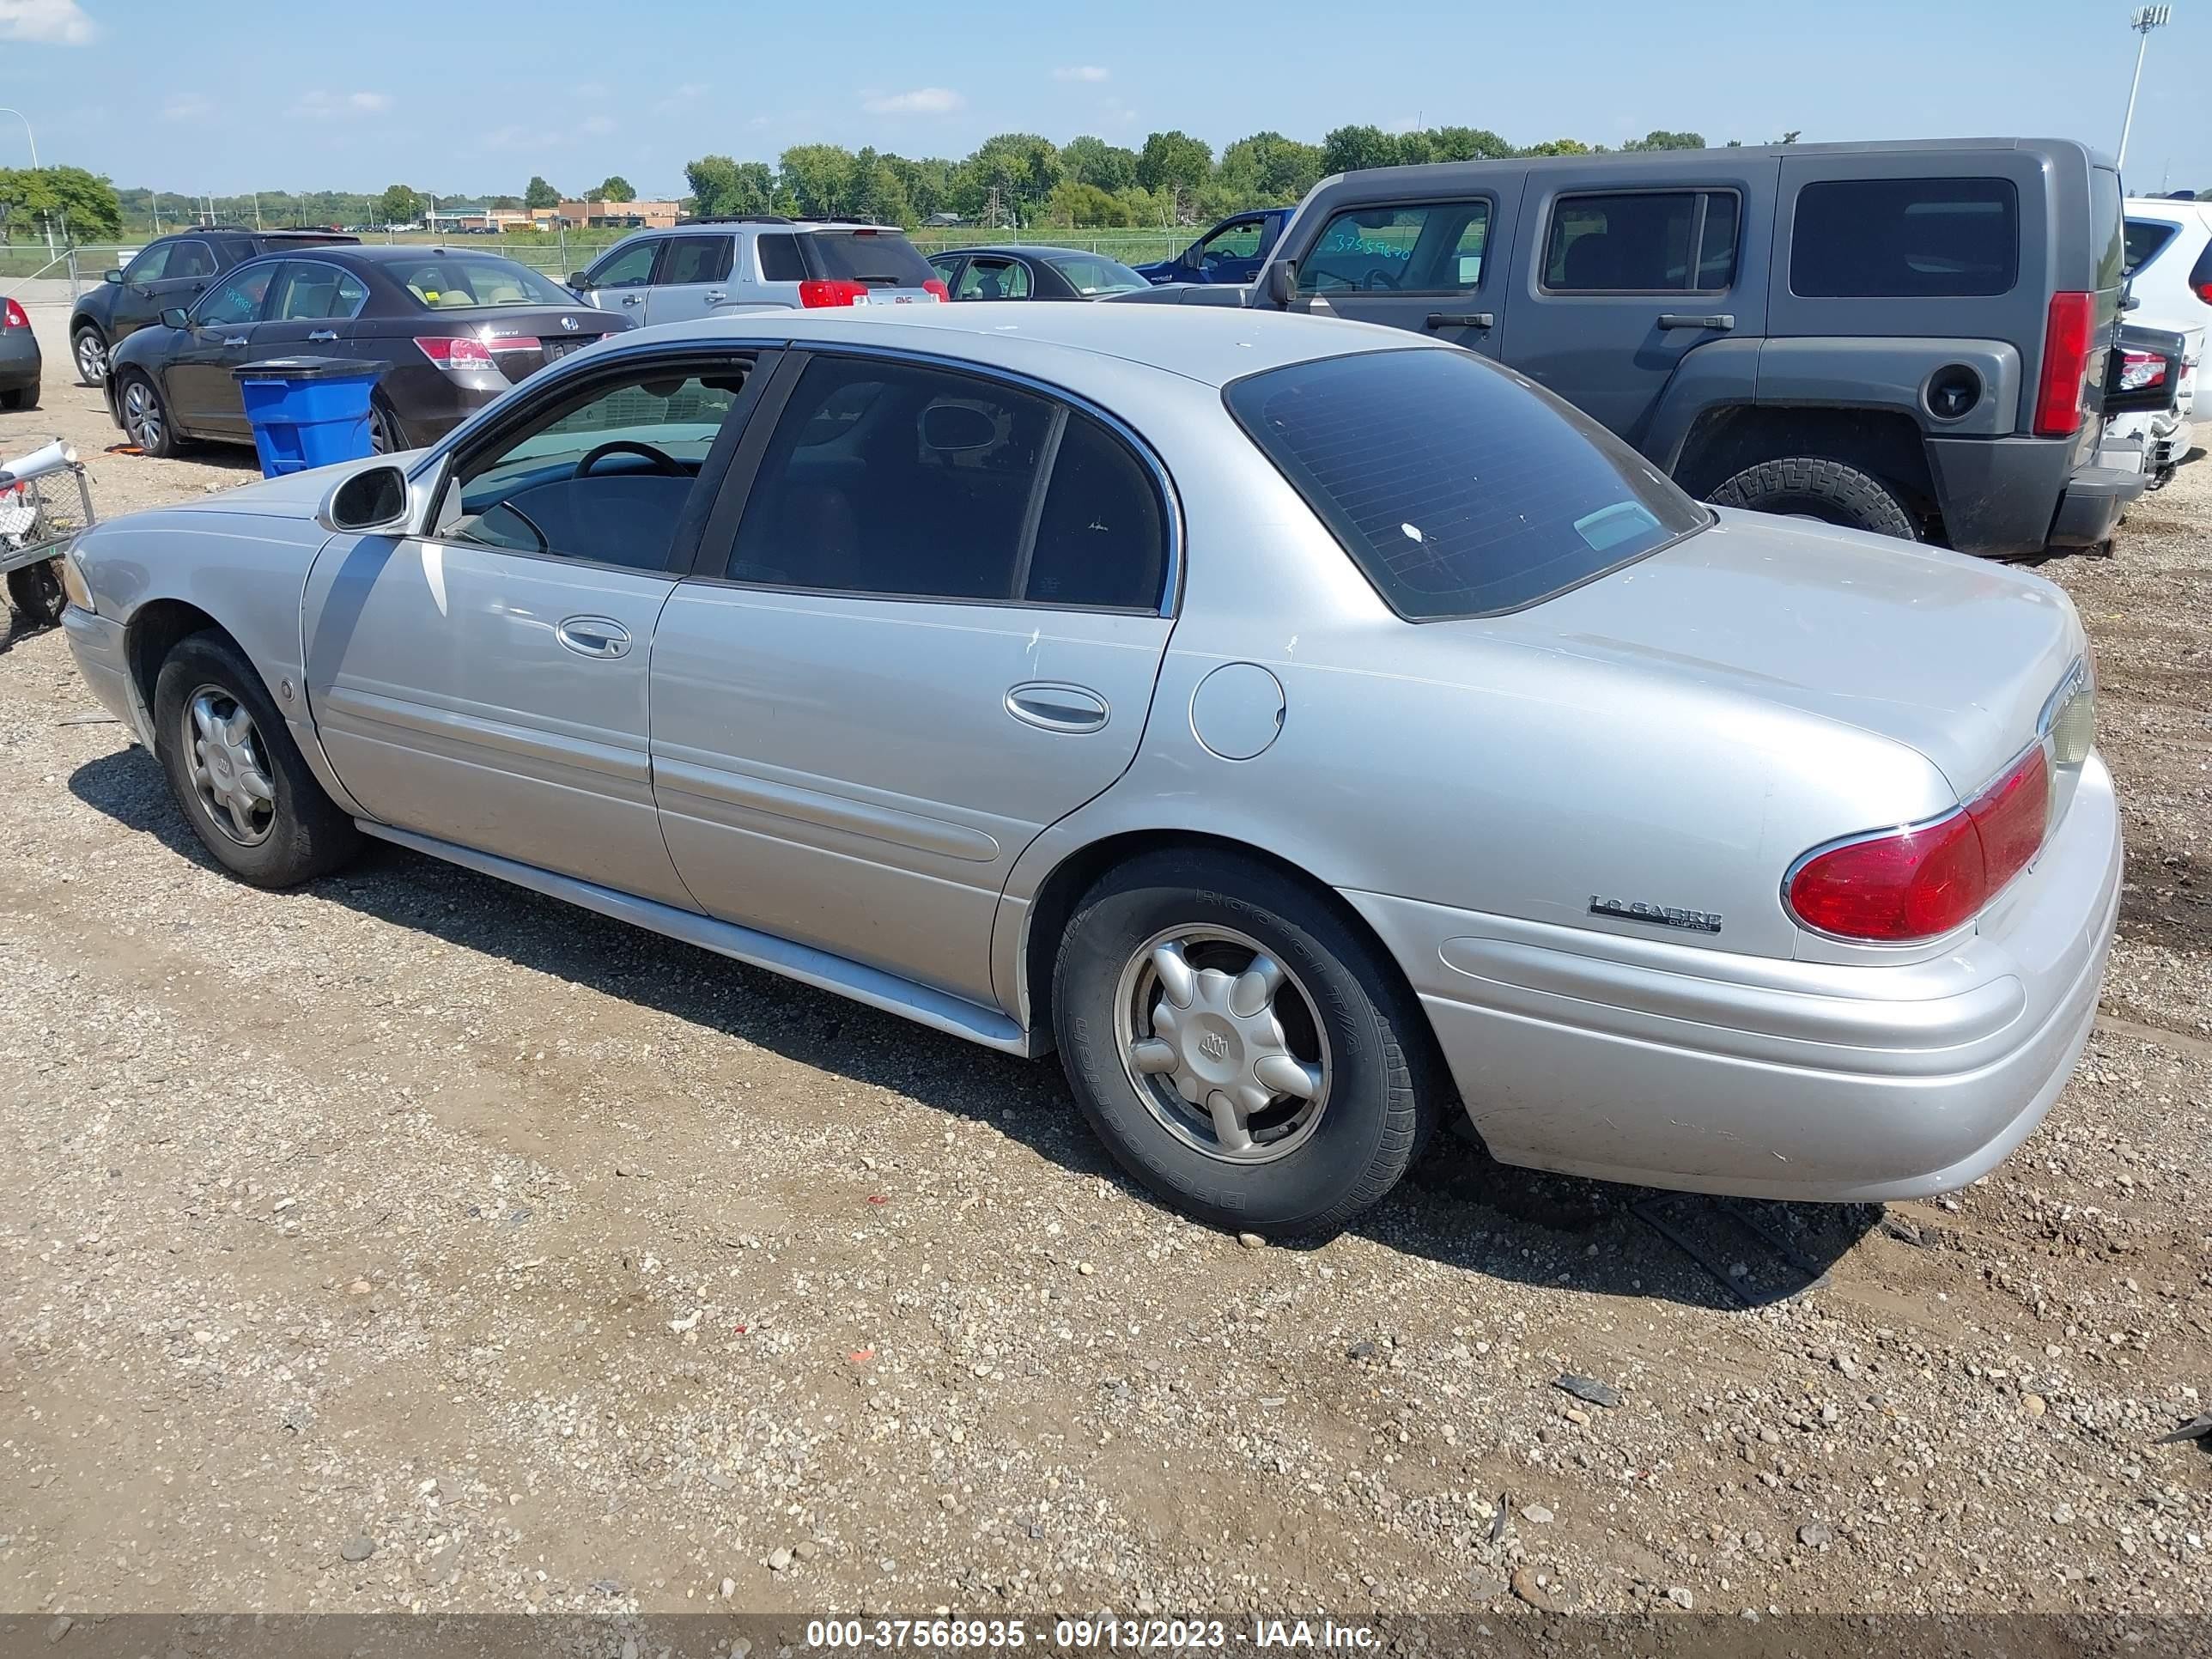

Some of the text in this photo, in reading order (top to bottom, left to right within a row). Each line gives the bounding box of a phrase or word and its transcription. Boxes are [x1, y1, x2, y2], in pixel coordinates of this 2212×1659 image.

[1335, 234, 1411, 260] 37559670
[1630, 901, 1723, 925] SABRE
[1668, 919, 1712, 931] CUSTOM
